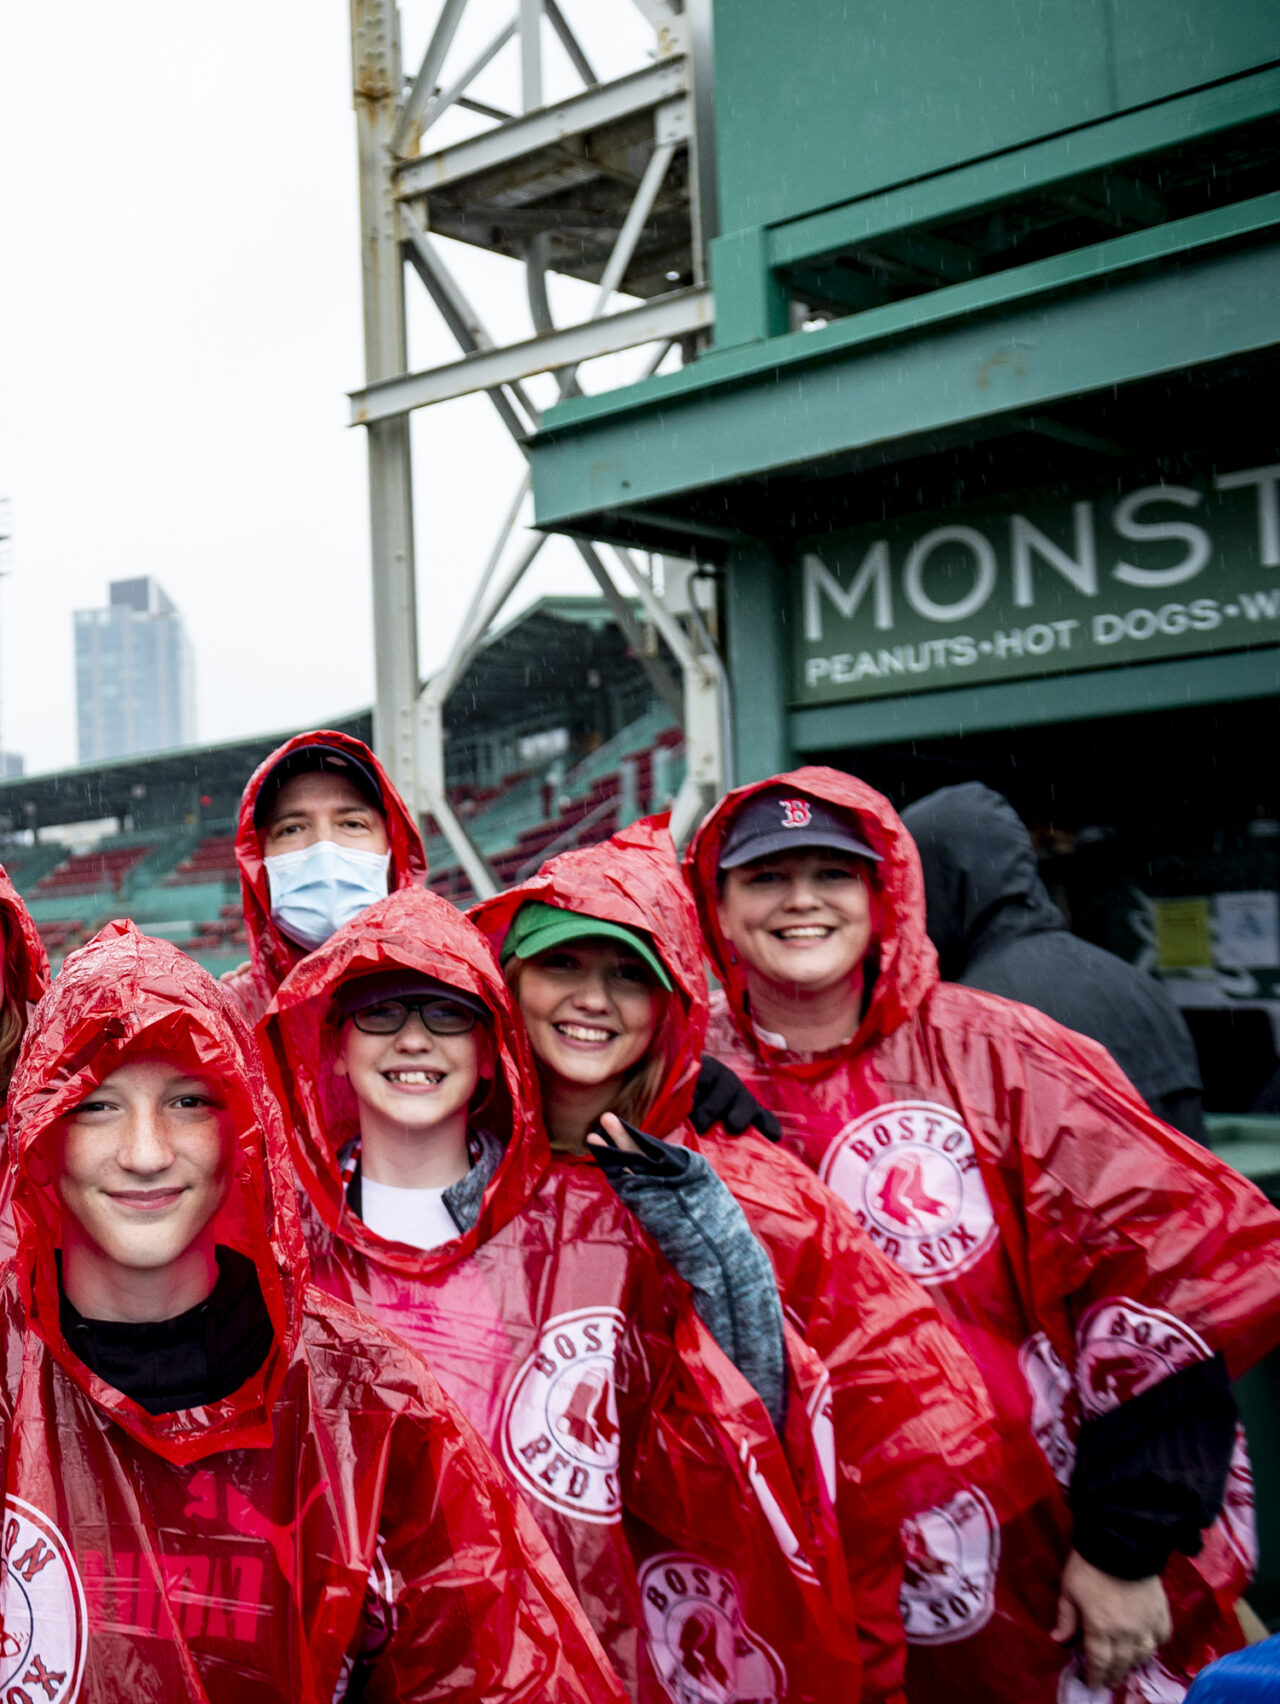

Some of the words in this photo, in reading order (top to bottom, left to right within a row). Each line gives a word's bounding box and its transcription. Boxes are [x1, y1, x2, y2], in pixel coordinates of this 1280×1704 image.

[805, 636, 978, 687] PEANUTS
[994, 619, 1079, 658] HOT
[1092, 599, 1221, 645] DOGS
[779, 798, 813, 829] B
[918, 1223, 978, 1268] SOX
[520, 1435, 589, 1499] RED
[929, 1575, 982, 1628] SOX
